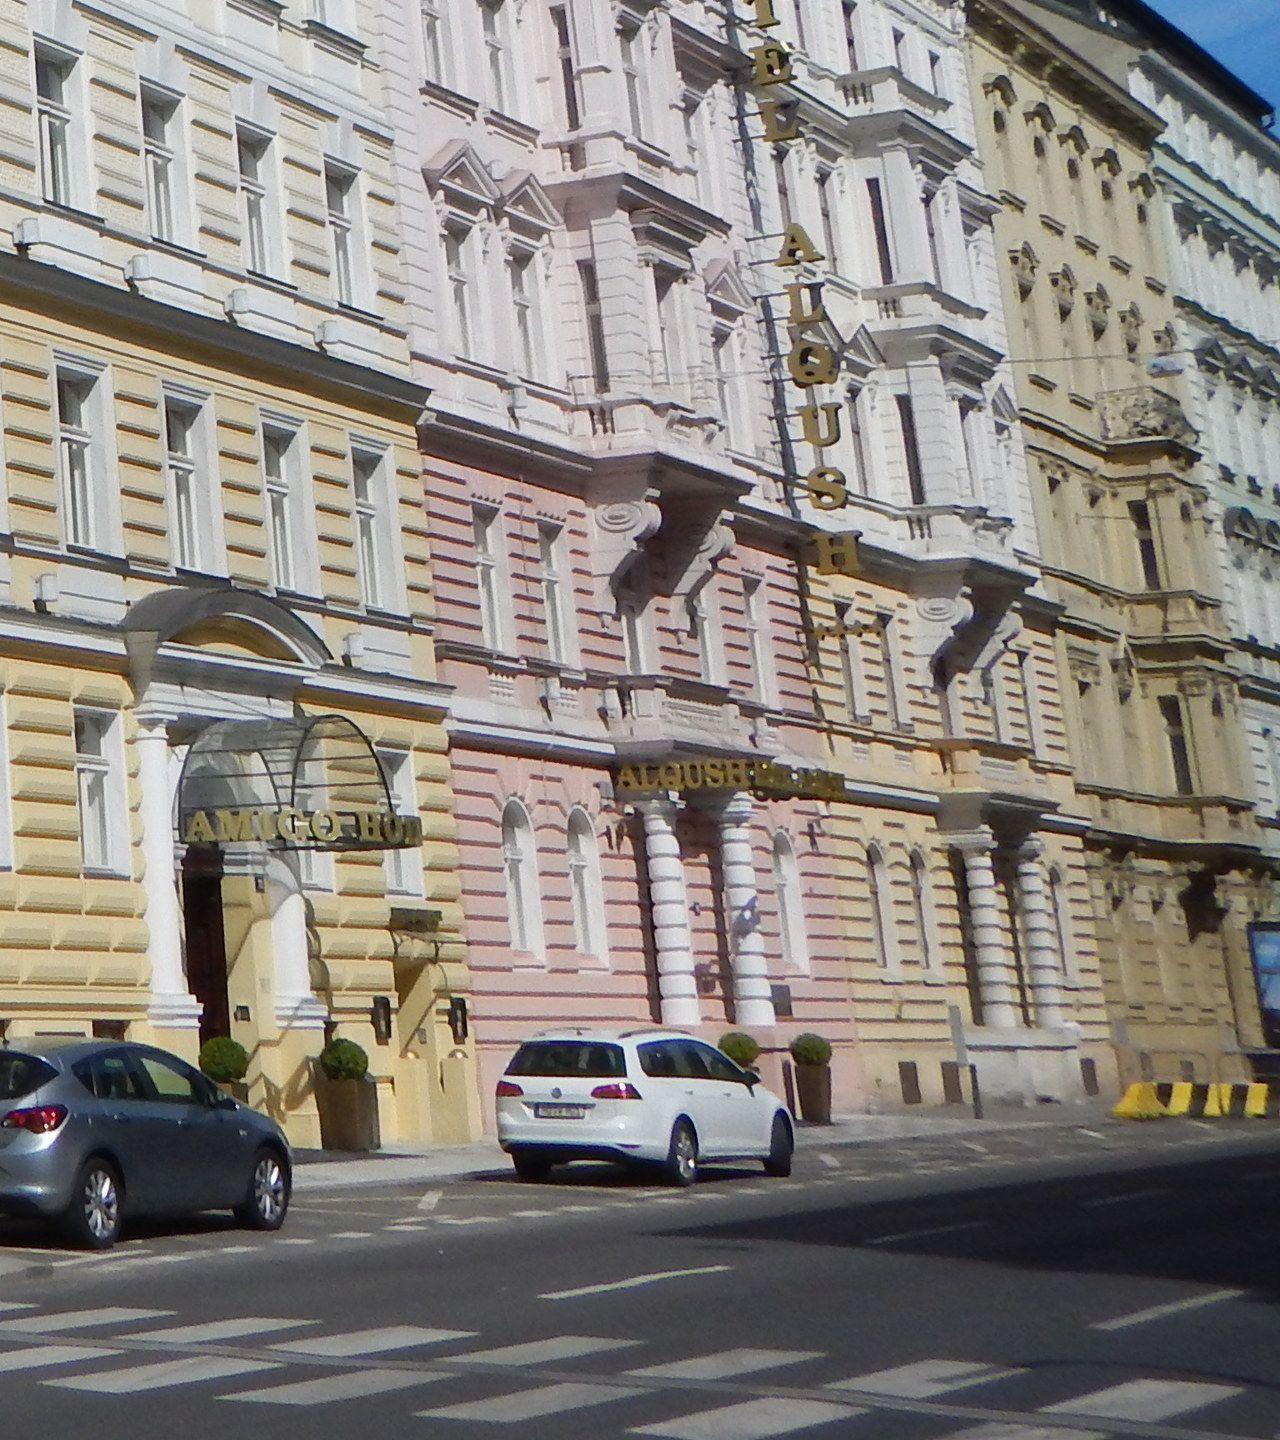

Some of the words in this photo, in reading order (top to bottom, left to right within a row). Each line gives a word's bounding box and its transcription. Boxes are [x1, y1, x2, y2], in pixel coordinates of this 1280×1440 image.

[774, 222, 863, 576] ALQUSH
[615, 760, 755, 791] ALQUSH
[185, 808, 343, 842] AMIGO
